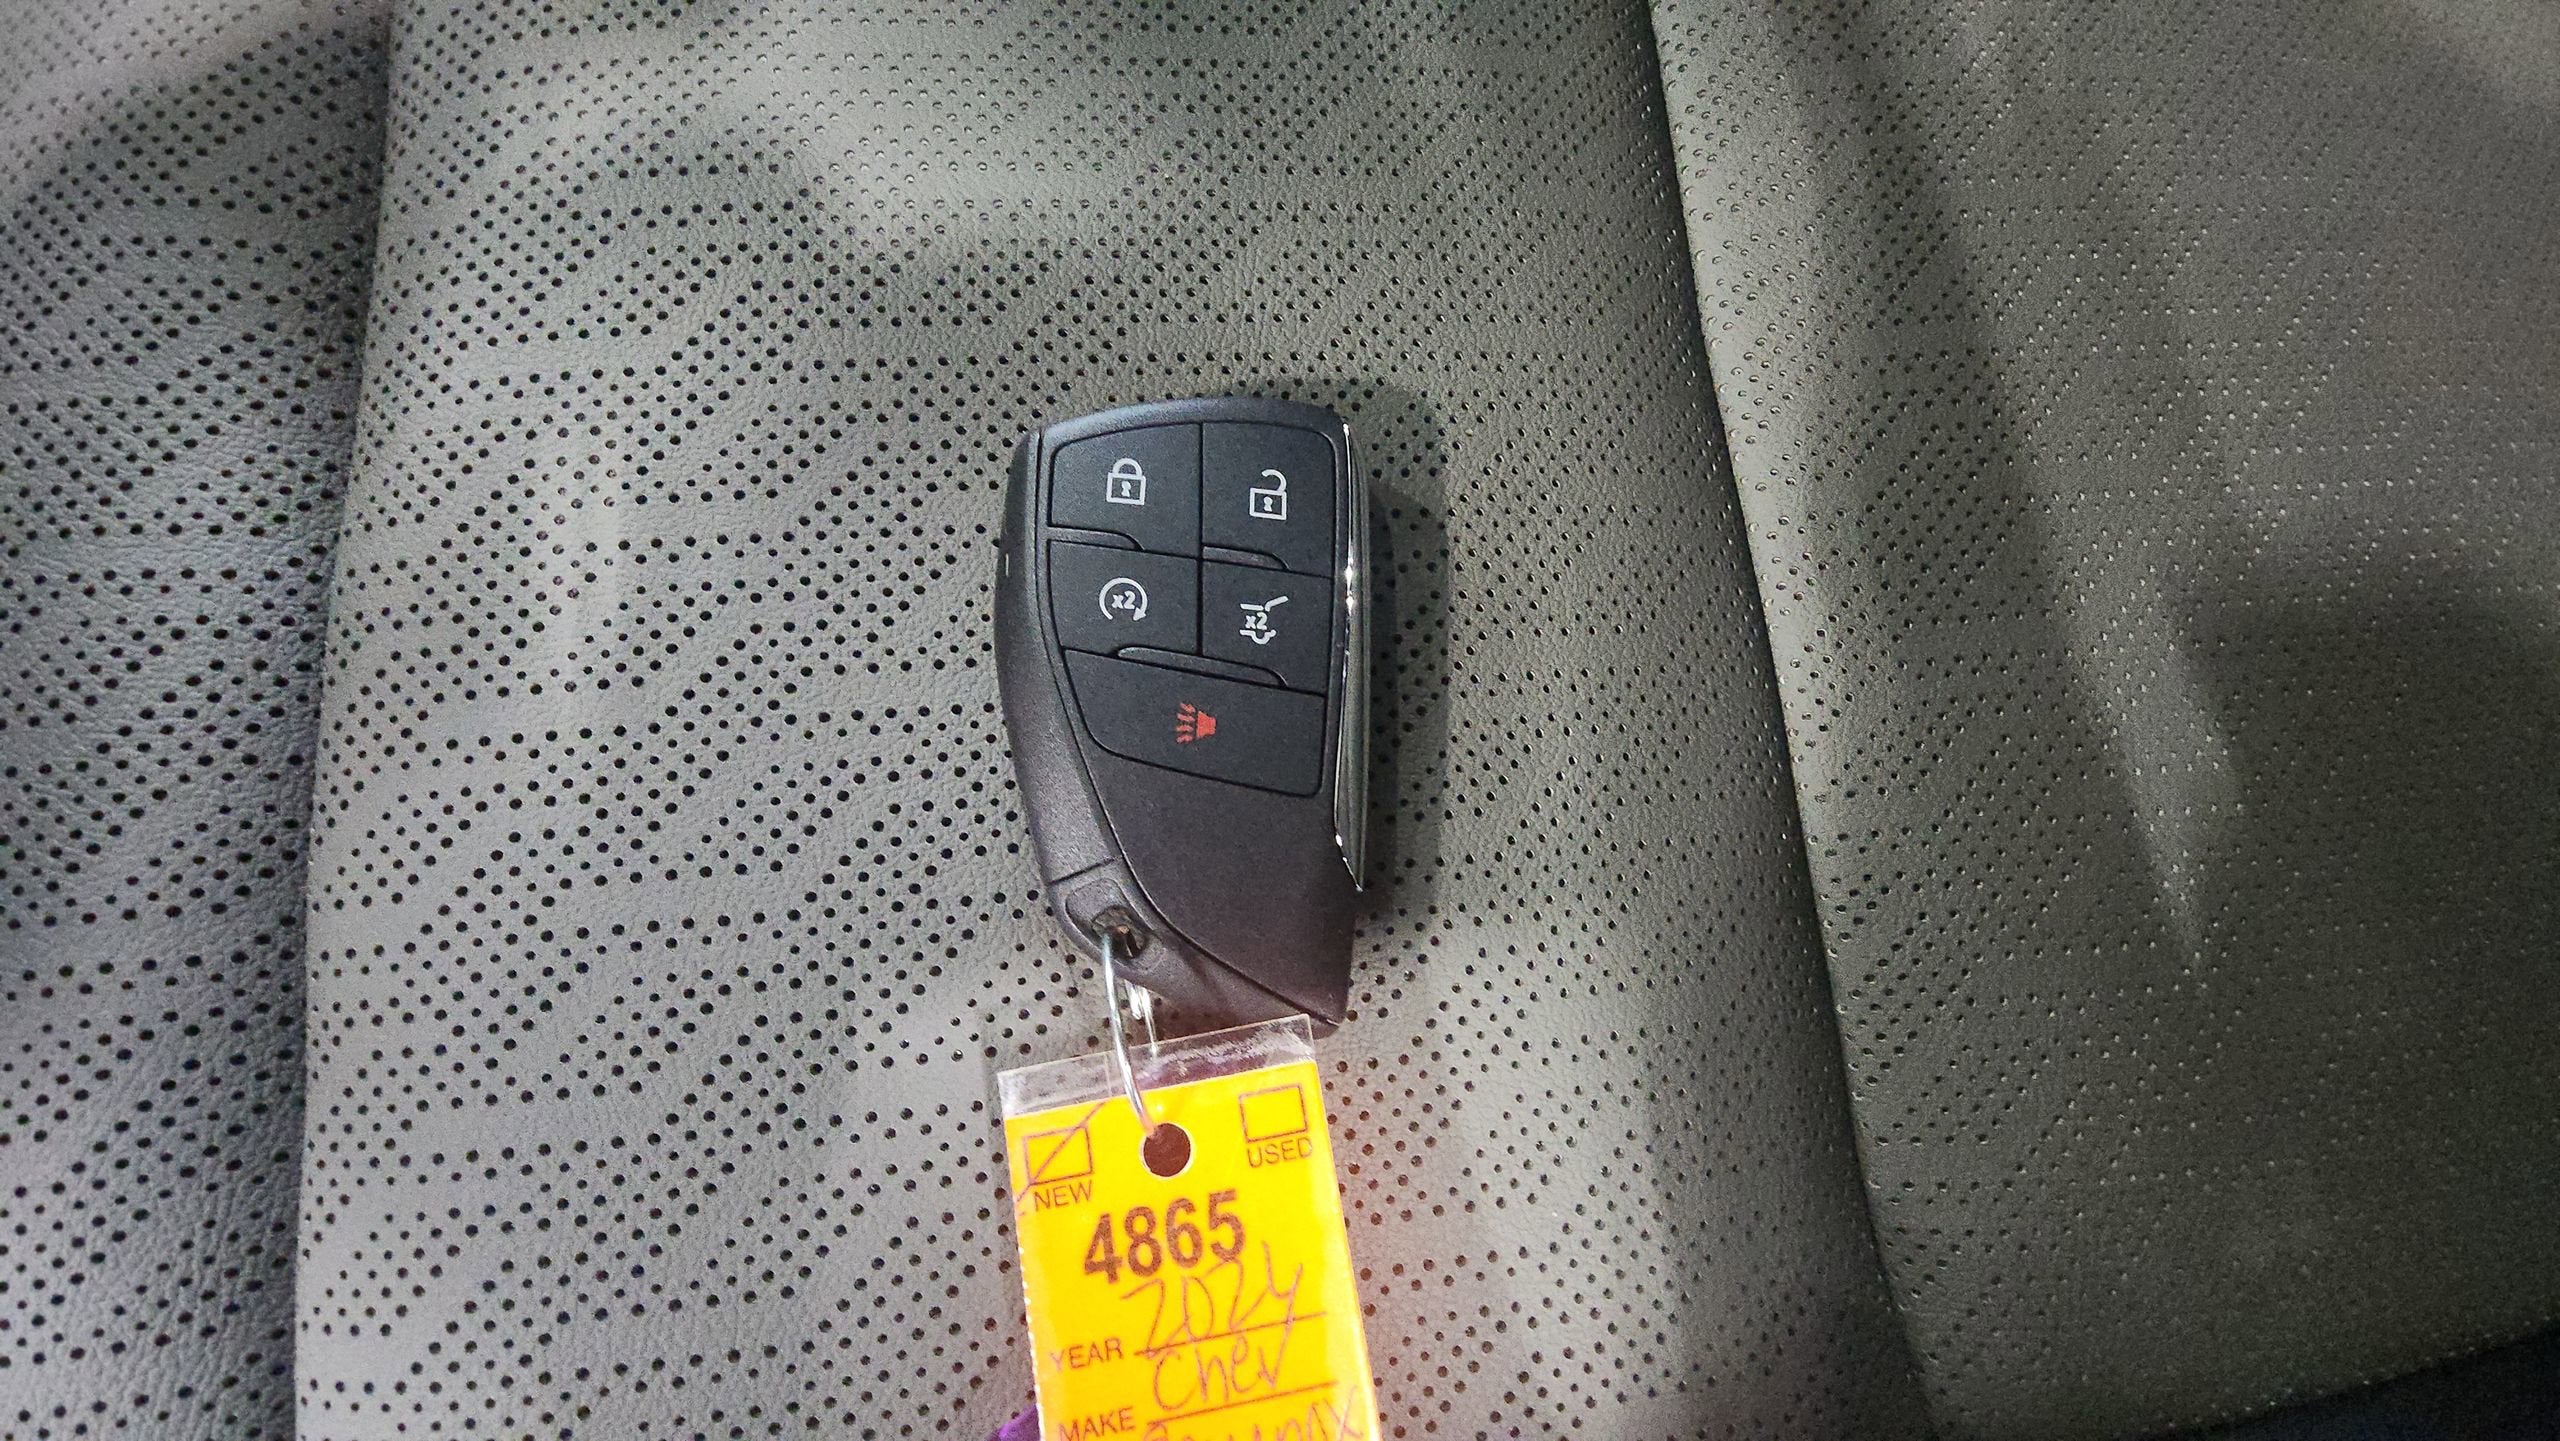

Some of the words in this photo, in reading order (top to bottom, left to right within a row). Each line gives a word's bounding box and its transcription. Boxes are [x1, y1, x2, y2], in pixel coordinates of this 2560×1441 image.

[1247, 1136, 1314, 1169] USED
[1033, 1179, 1093, 1212] NEW
[1083, 1189, 1246, 1285] 4865
[1120, 1242, 1304, 1362] 2024
[1050, 1337, 1123, 1374] YEAR
[1057, 1405, 1137, 1441] MAKE
